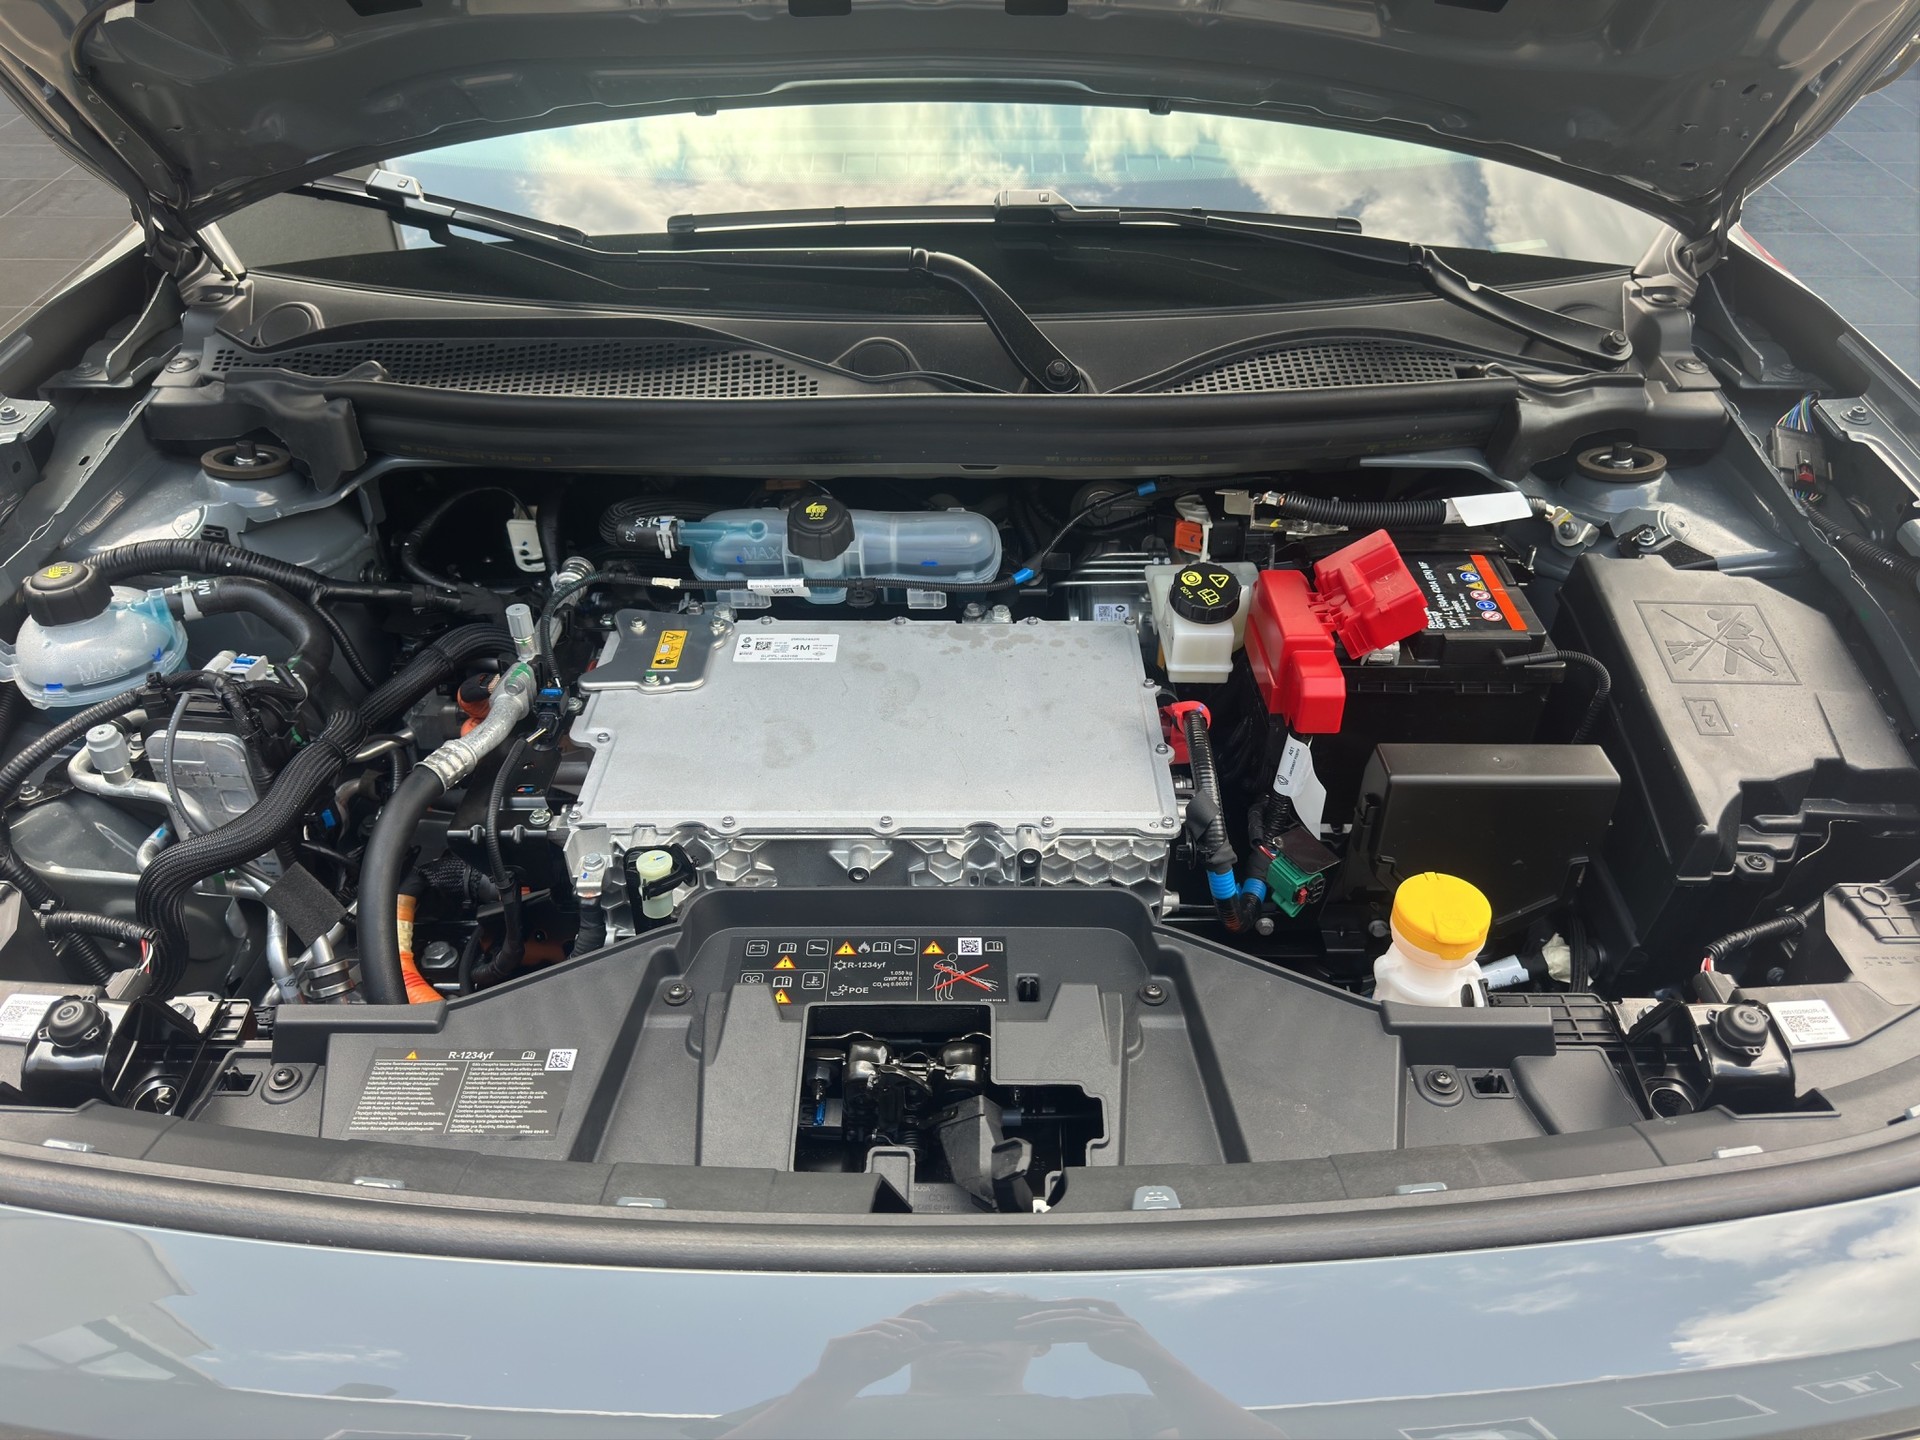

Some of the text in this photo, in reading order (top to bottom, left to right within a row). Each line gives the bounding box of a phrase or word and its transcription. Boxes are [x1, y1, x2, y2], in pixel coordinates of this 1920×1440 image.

[743, 545, 781, 559] MAX
[76, 655, 127, 681] MAX
[847, 961, 886, 970] R-1234yf
[448, 1051, 494, 1061] R-1234yf
